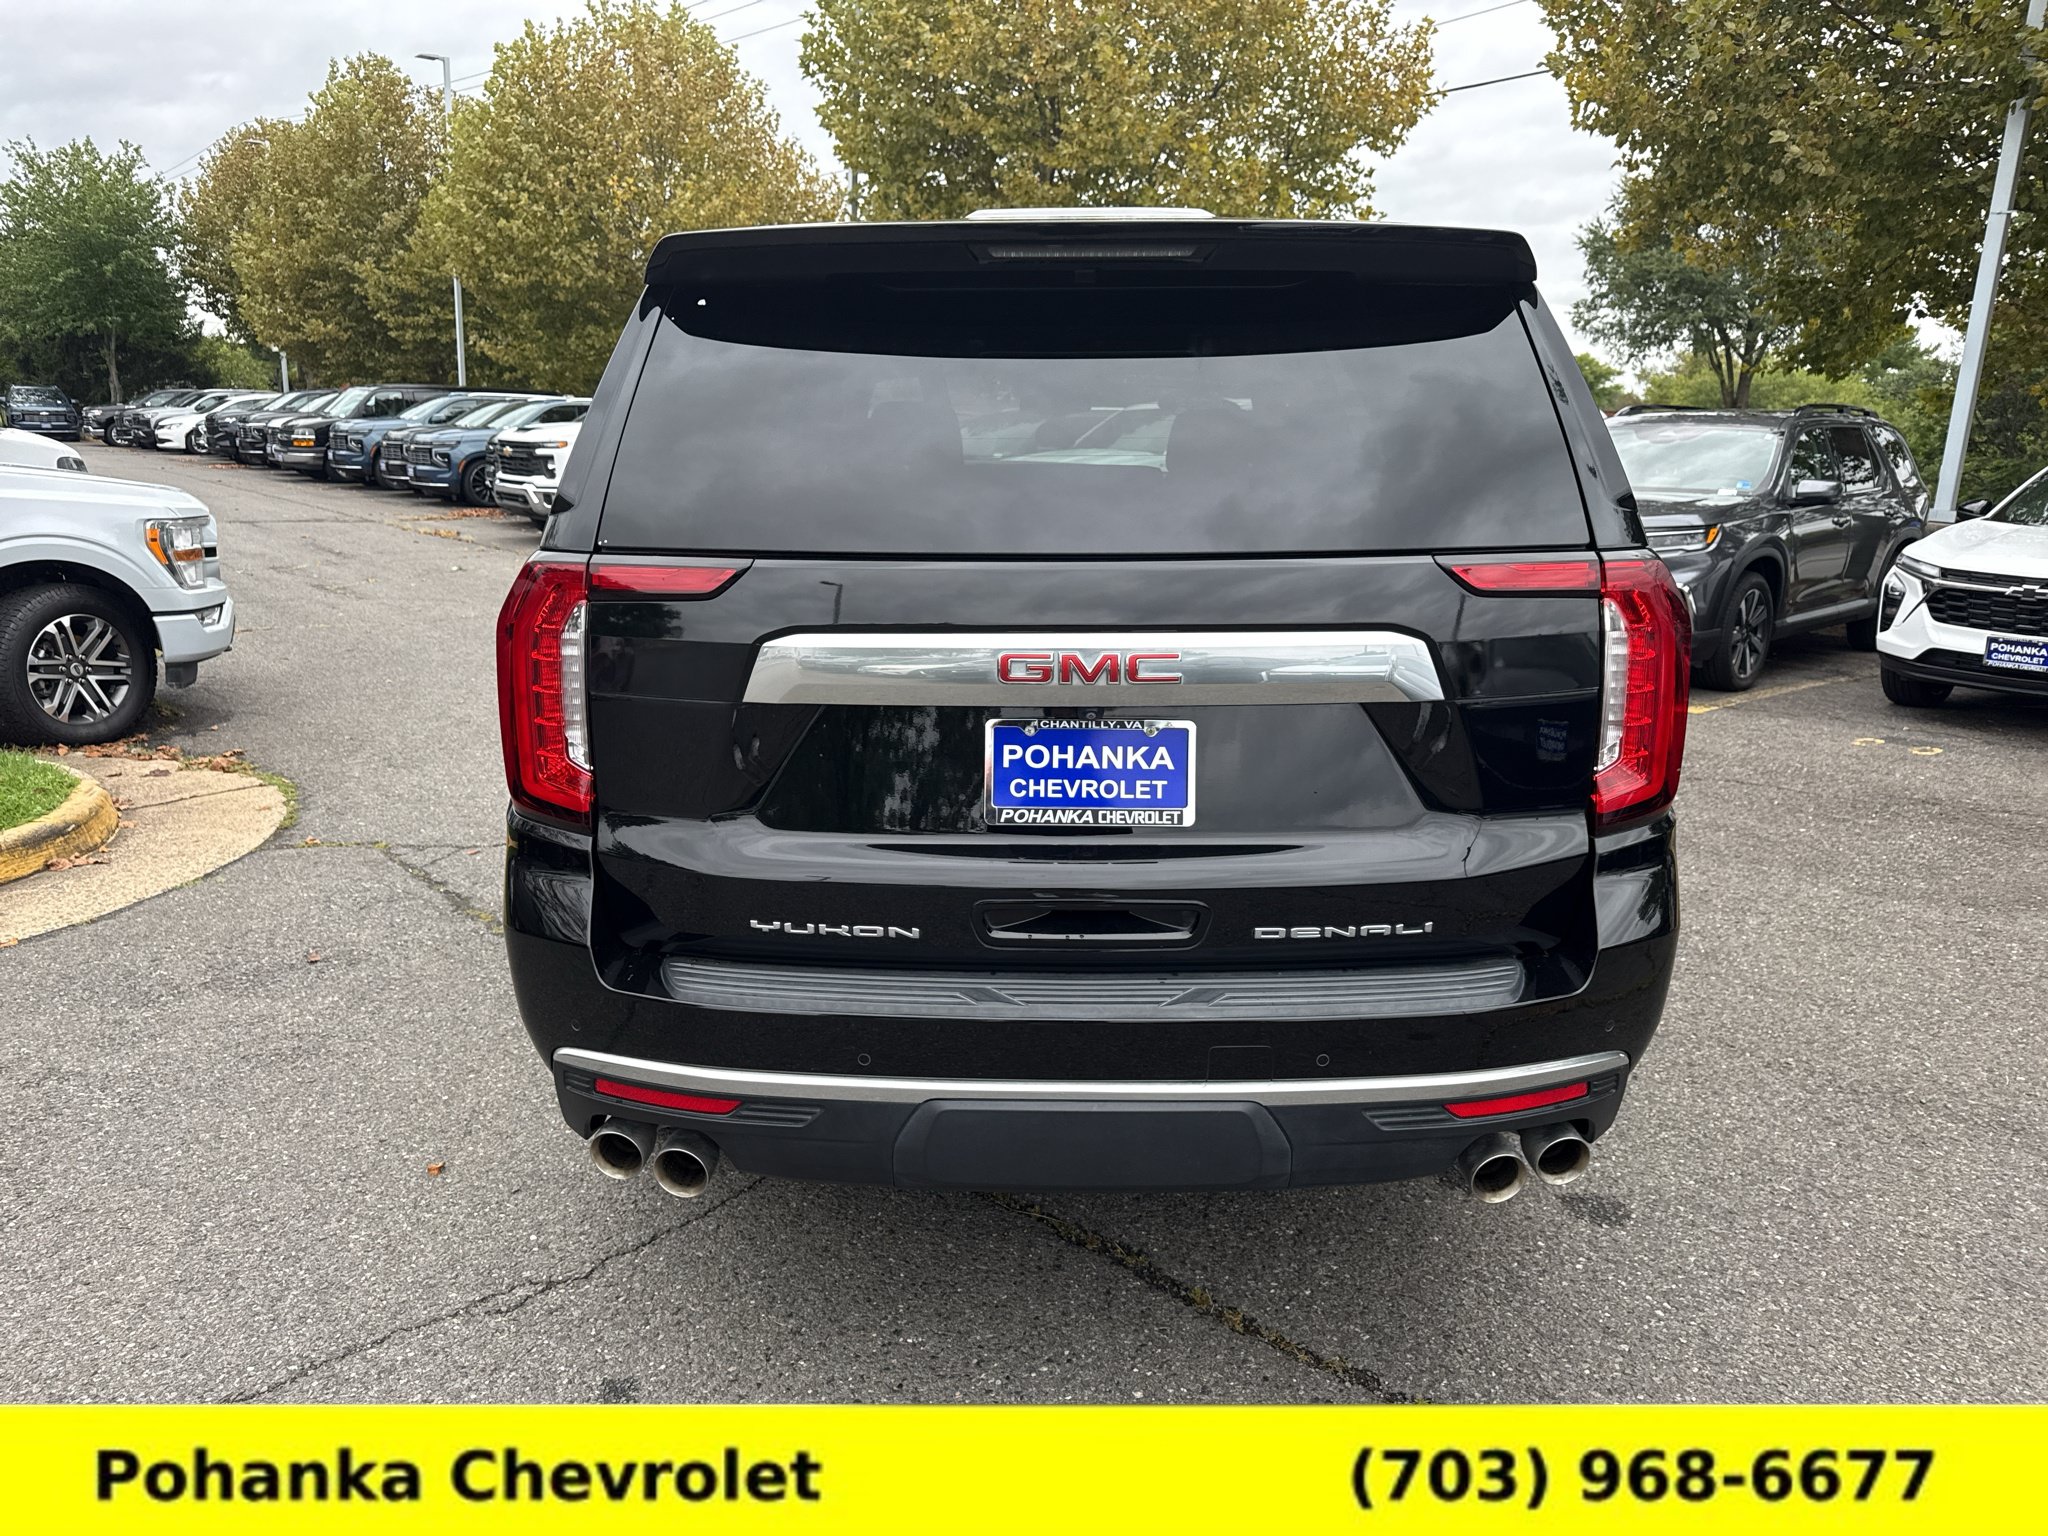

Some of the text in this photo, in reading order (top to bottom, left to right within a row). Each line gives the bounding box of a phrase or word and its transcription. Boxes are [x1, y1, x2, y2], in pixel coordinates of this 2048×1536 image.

[1990, 642, 2048, 657] POHANKA
[1991, 652, 2045, 665] CHEVROLET
[997, 651, 1183, 685] GMC
[1125, 720, 1142, 729] VA
[1002, 744, 1175, 770] POHANKA
[1009, 779, 1168, 799] CHEVROLET
[1000, 808, 1181, 824] POHANKA CHEVROLET
[750, 920, 920, 939] YUKON
[1254, 921, 1433, 939] DENALI
